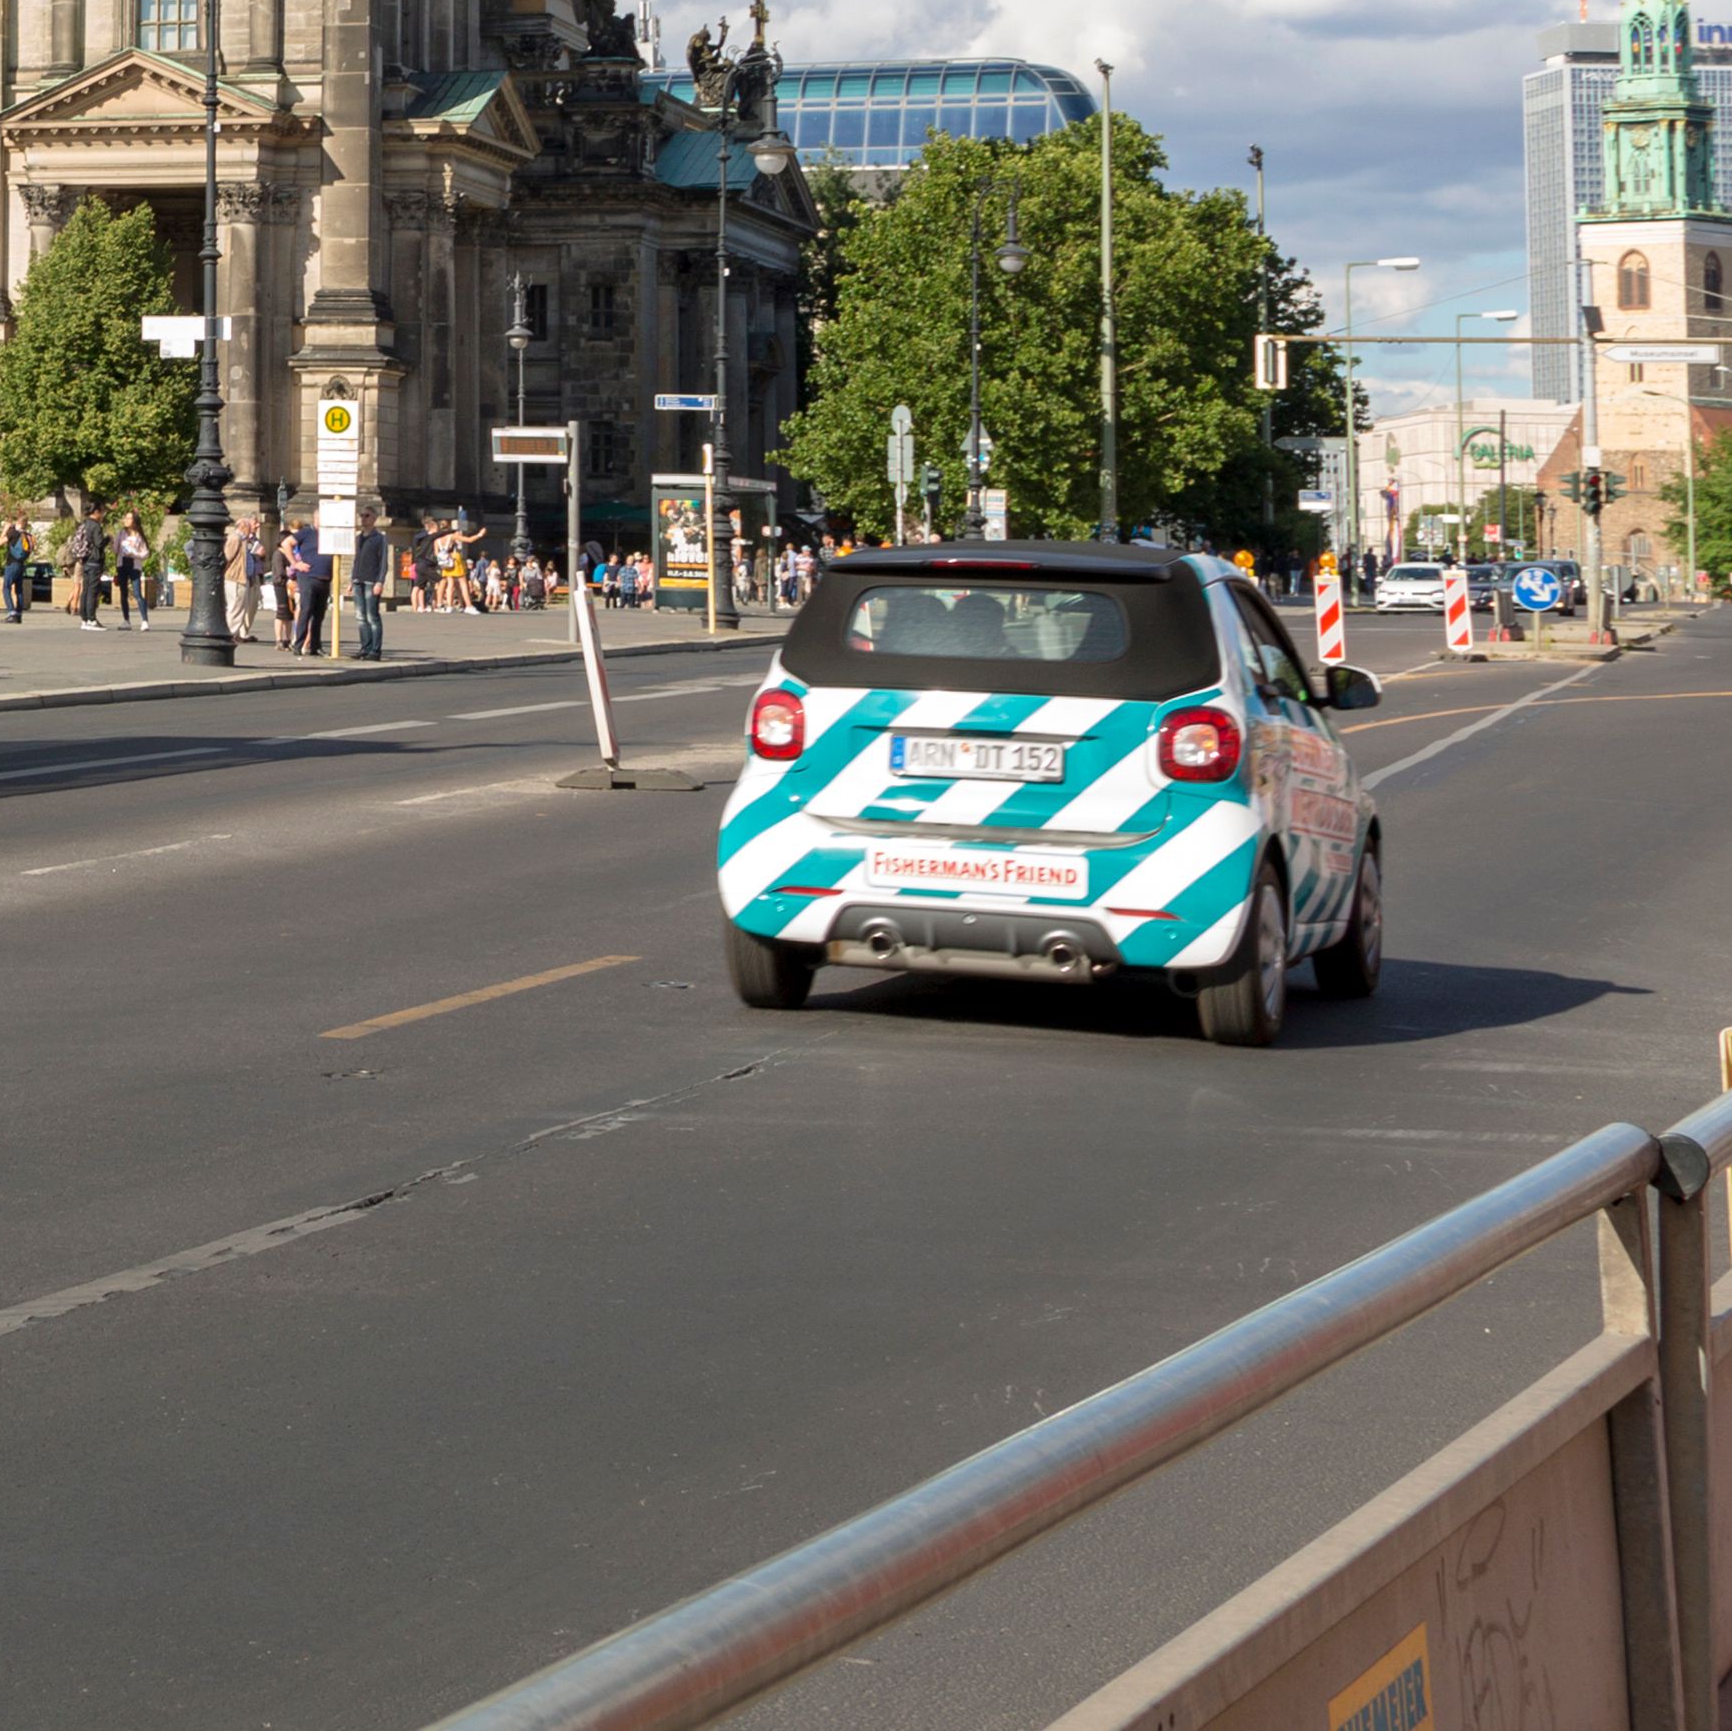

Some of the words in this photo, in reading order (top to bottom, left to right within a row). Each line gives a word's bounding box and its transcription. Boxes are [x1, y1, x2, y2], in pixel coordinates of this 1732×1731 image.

[909, 740, 955, 767] ARN
[975, 744, 1006, 769] DT
[1012, 745, 1058, 772] 152
[1003, 859, 1077, 884] FRIEND
